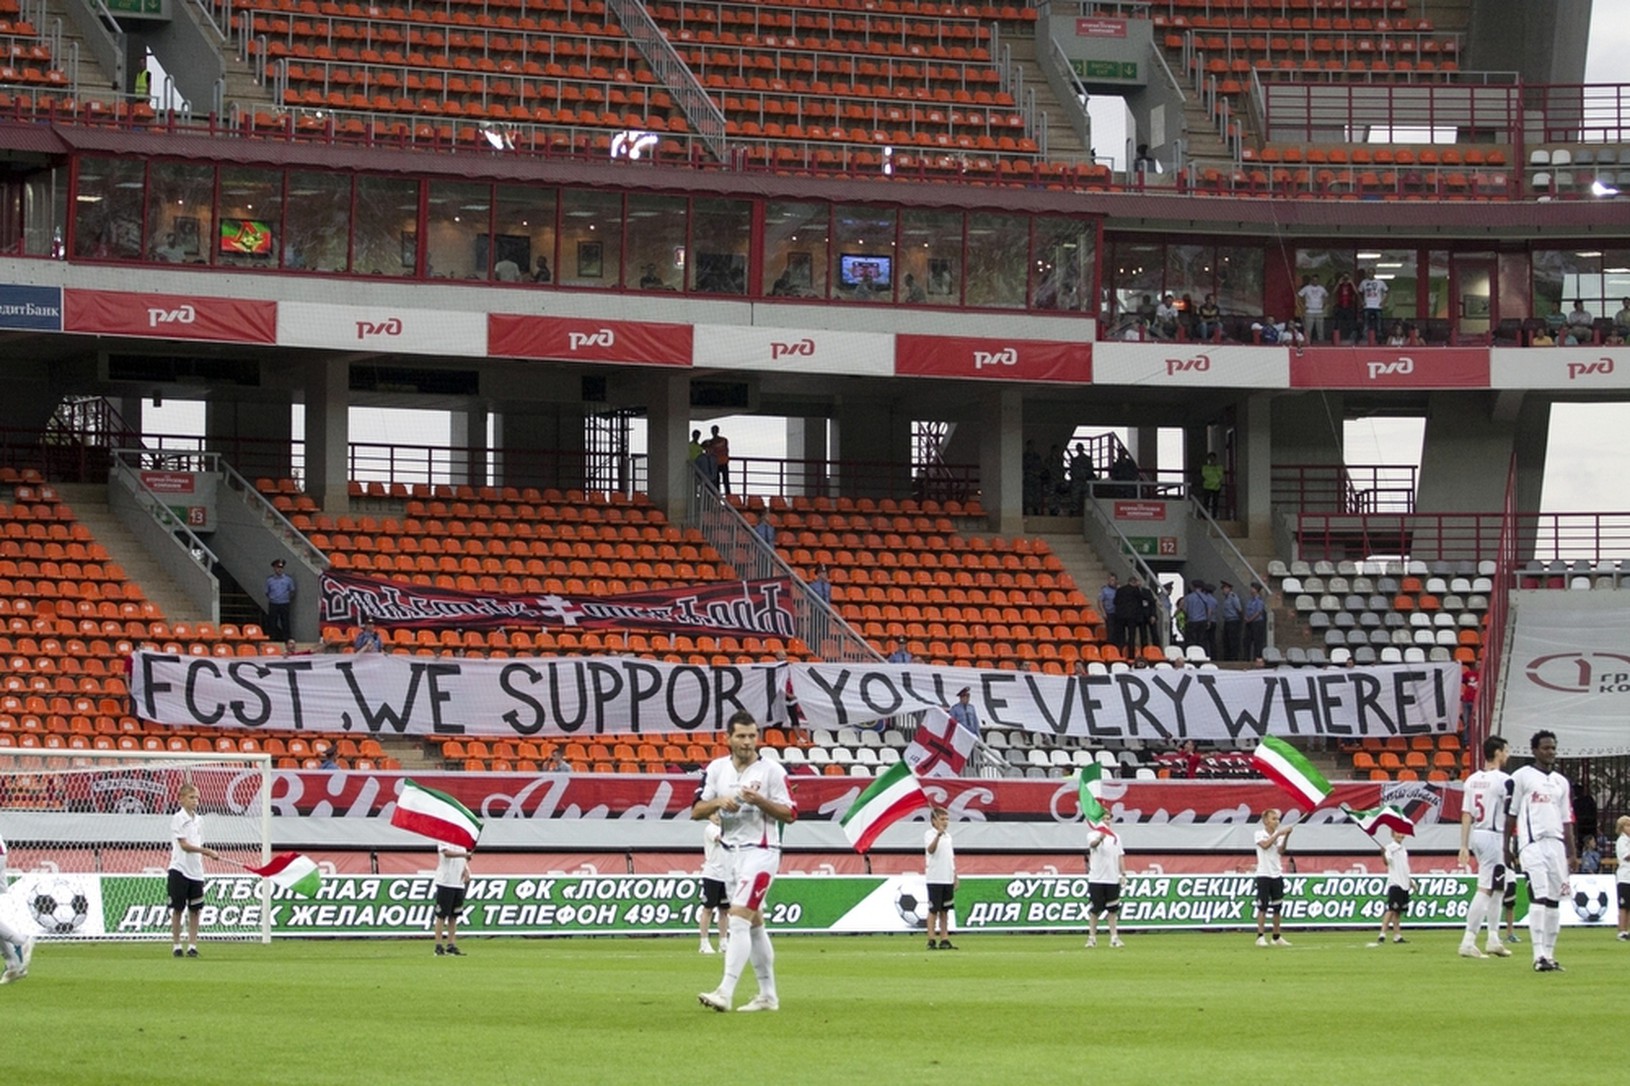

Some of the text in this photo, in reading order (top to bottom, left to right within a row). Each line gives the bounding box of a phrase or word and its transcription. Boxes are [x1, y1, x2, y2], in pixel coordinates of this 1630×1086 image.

[1162, 542, 1175, 553] 12
[499, 661, 789, 735] SUPPORT
[981, 668, 1447, 738] EVERYWHERE!
[1475, 794, 1485, 823] 5
[389, 879, 507, 900] СЕИЯ
[515, 879, 555, 900] ФК
[736, 880, 748, 898] 7
[1007, 879, 1170, 899] ФУТБОНАЯ
[1312, 878, 1469, 898] «ЛОКОТИВ»
[119, 905, 184, 931] ДЛ
[288, 905, 475, 930] ЖЕЛАЮЩХ
[484, 904, 617, 925] ТЕЛЕФОН
[966, 903, 1022, 926] ДЛЯ
[1027, 903, 1094, 921] ВСЕХ
